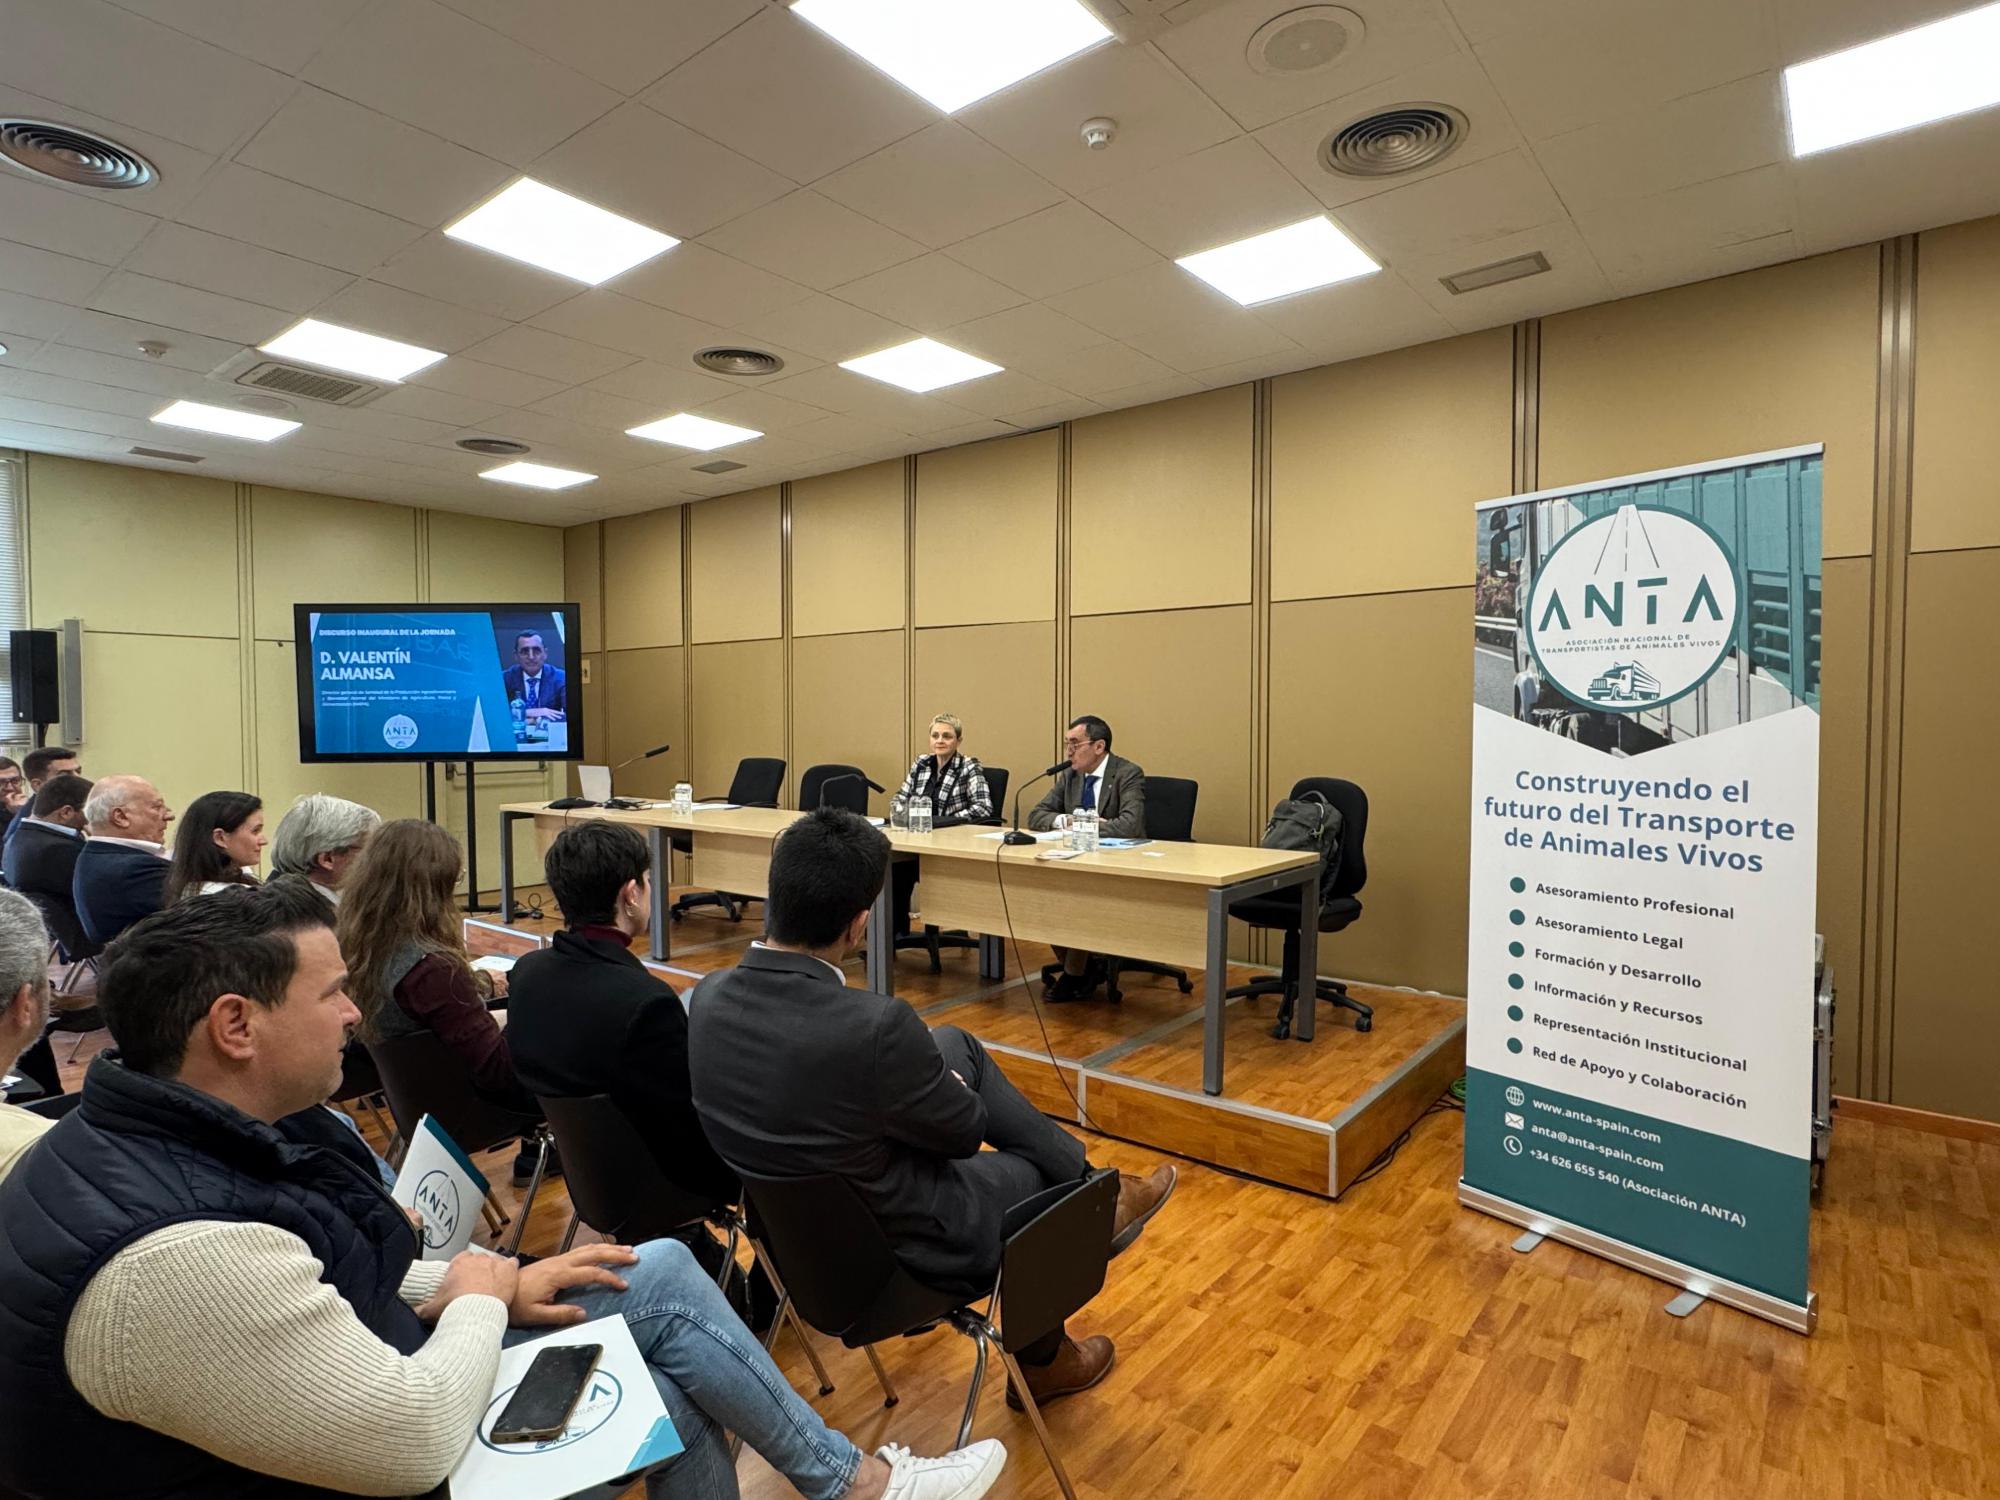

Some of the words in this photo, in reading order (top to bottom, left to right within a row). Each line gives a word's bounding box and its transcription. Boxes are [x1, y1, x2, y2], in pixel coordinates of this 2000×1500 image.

[1538, 573, 1724, 632] ANTA
[320, 651, 336, 664] D.
[338, 647, 411, 664] VALENTÍN
[1541, 645, 1616, 654] TRANSPORTISTAS
[1635, 641, 1685, 650] ANIMALES
[1690, 640, 1721, 648] VIVOS
[1566, 637, 1620, 647] ASOCIACIÓN
[1623, 634, 1673, 644] NACIONAL
[320, 667, 395, 680] ALMANSA
[1515, 770, 1712, 802] Construyendo
[1722, 780, 1749, 803] el
[1484, 796, 1562, 822] futuro
[1569, 803, 1608, 826] del
[1617, 806, 1795, 841] Transporte
[1504, 827, 1533, 848] de
[1540, 830, 1668, 863] Animales
[1678, 843, 1763, 872] Vivos
[1535, 882, 1639, 907] Asesoramiento
[1643, 897, 1735, 920] Profesional
[1535, 915, 1639, 942] Asesoramiento
[1643, 932, 1683, 950] Legal
[1535, 948, 1605, 971] Formación
[1608, 963, 1618, 976] y
[1621, 964, 1702, 989] Desarrollo
[1534, 980, 1617, 1008] Información
[1620, 1000, 1630, 1012] y
[1633, 1001, 1703, 1025] Recursos
[1533, 1013, 1641, 1048] Representación
[1645, 1038, 1747, 1072] Institucional
[1533, 1046, 1556, 1062] Red
[1560, 1052, 1577, 1067] de
[1580, 1058, 1625, 1080] Apoyo
[1628, 1071, 1637, 1084] y
[1641, 1073, 1747, 1110] Colaboración
[1532, 1099, 1661, 1144] www.anta-spain.com
[1531, 1122, 1664, 1172] anta@anta-spain.com
[419, 1185, 454, 1233] ANTA
[1529, 1147, 1549, 1163] +34
[1551, 1154, 1572, 1170] 626
[1574, 1162, 1596, 1178] 655
[1598, 1170, 1620, 1185] 540
[1622, 1176, 1698, 1211] (Asociación
[1700, 1202, 1747, 1228] ANTA)
